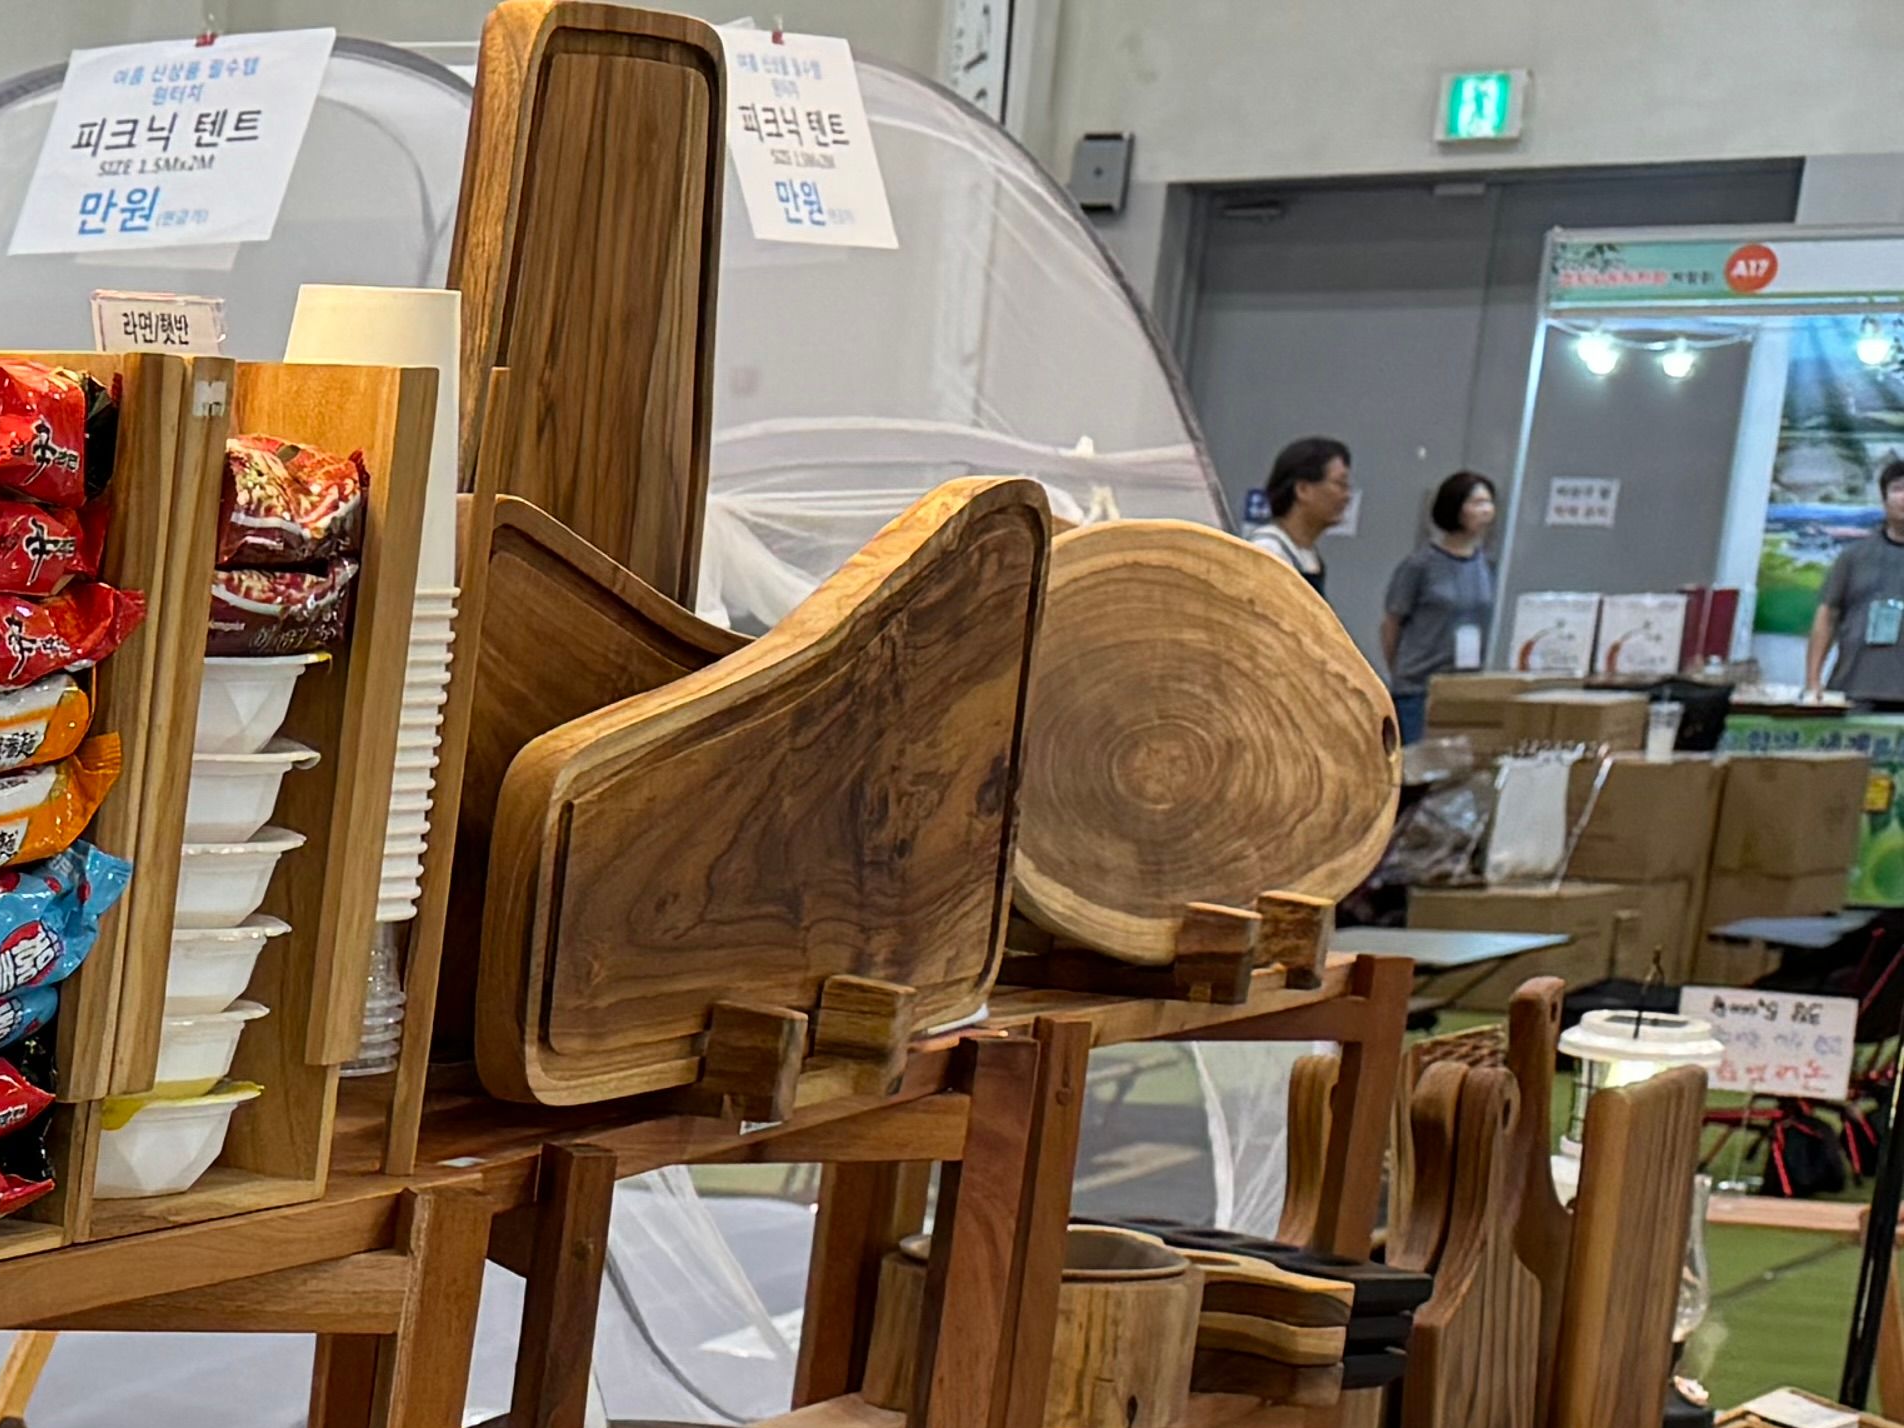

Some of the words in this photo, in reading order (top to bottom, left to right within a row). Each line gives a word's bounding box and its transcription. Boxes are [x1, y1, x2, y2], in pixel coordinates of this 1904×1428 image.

[71, 112, 179, 158] 피크닉
[193, 108, 261, 148] 텐트
[78, 186, 160, 235] 만원
